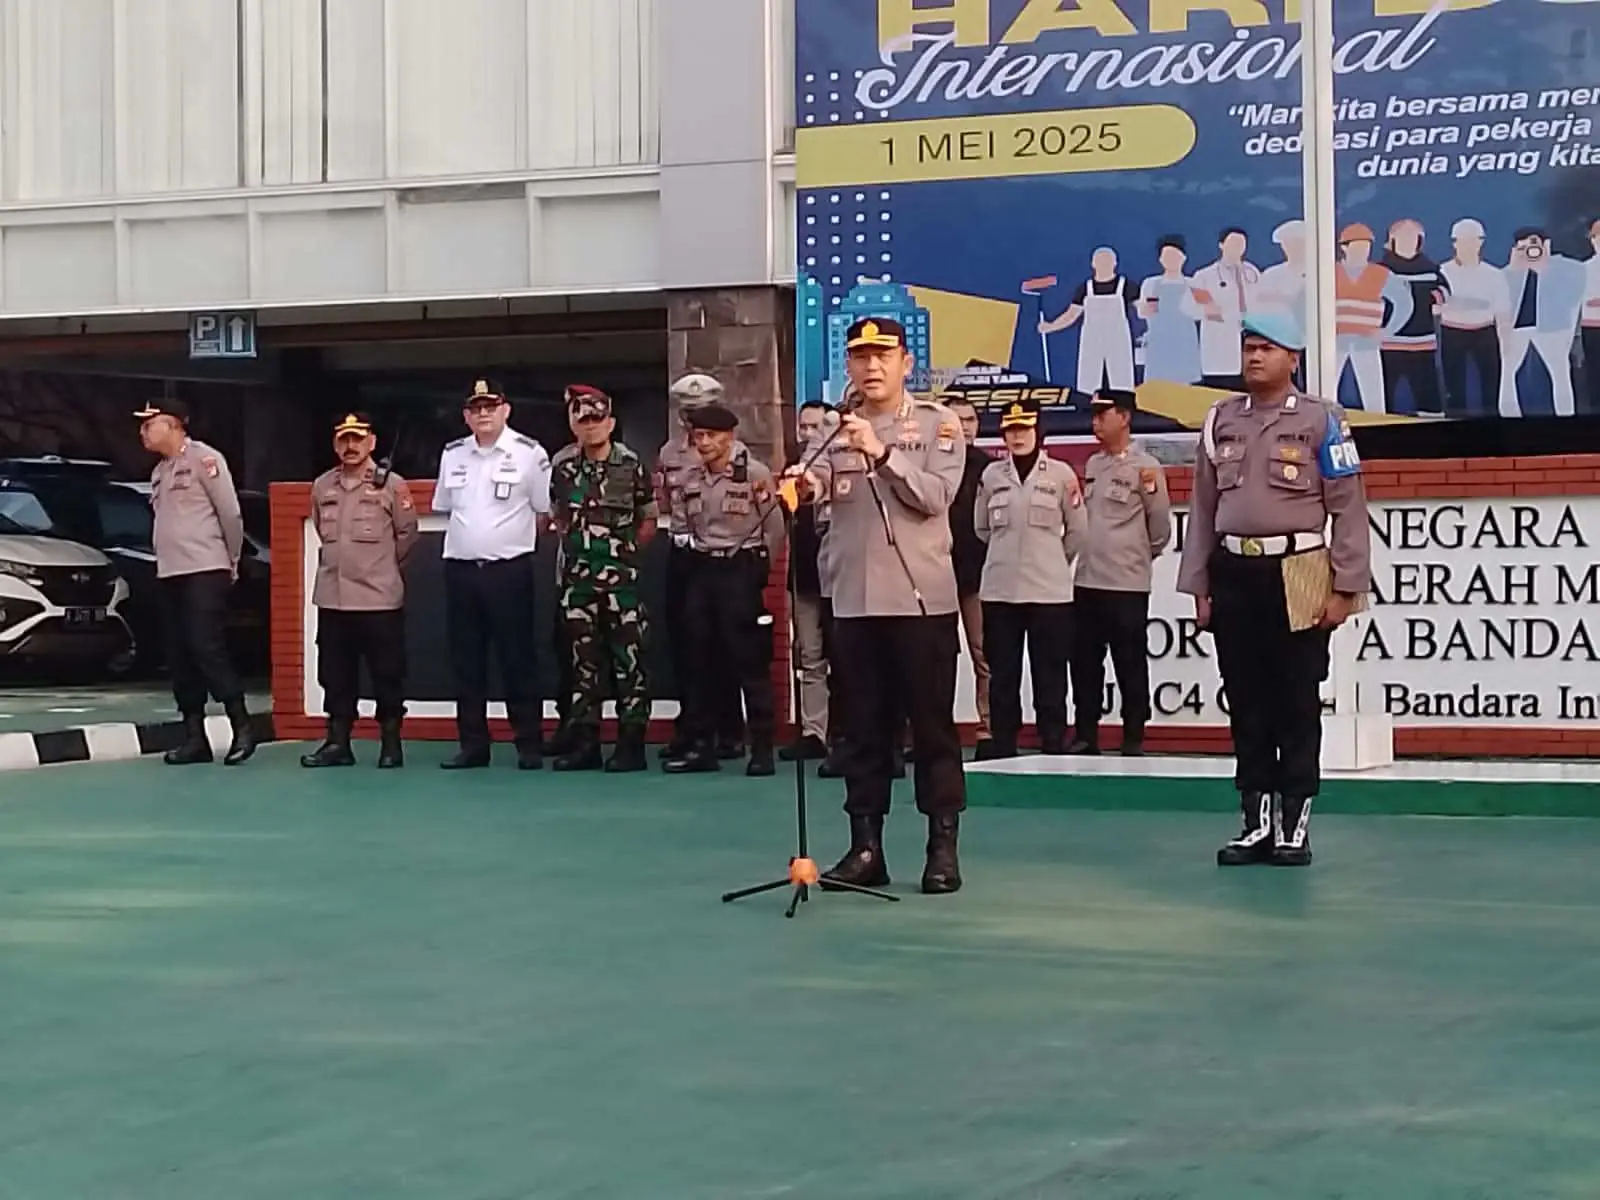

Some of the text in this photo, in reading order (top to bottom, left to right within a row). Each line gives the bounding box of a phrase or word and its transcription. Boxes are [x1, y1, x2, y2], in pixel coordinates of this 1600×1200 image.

[1228, 103, 1304, 128] “Mar
[1333, 98, 1377, 121] ita
[1385, 91, 1529, 118] bersama
[879, 122, 1122, 166] 1 MEI 2025
[1245, 113, 1591, 155] dedasi para pekerja
[1357, 151, 1449, 178] dunia
[1455, 150, 1540, 178] yang
[896, 442, 927, 452] OLRI
[1153, 681, 1205, 715] C4
[1382, 683, 1541, 718] Bandara
